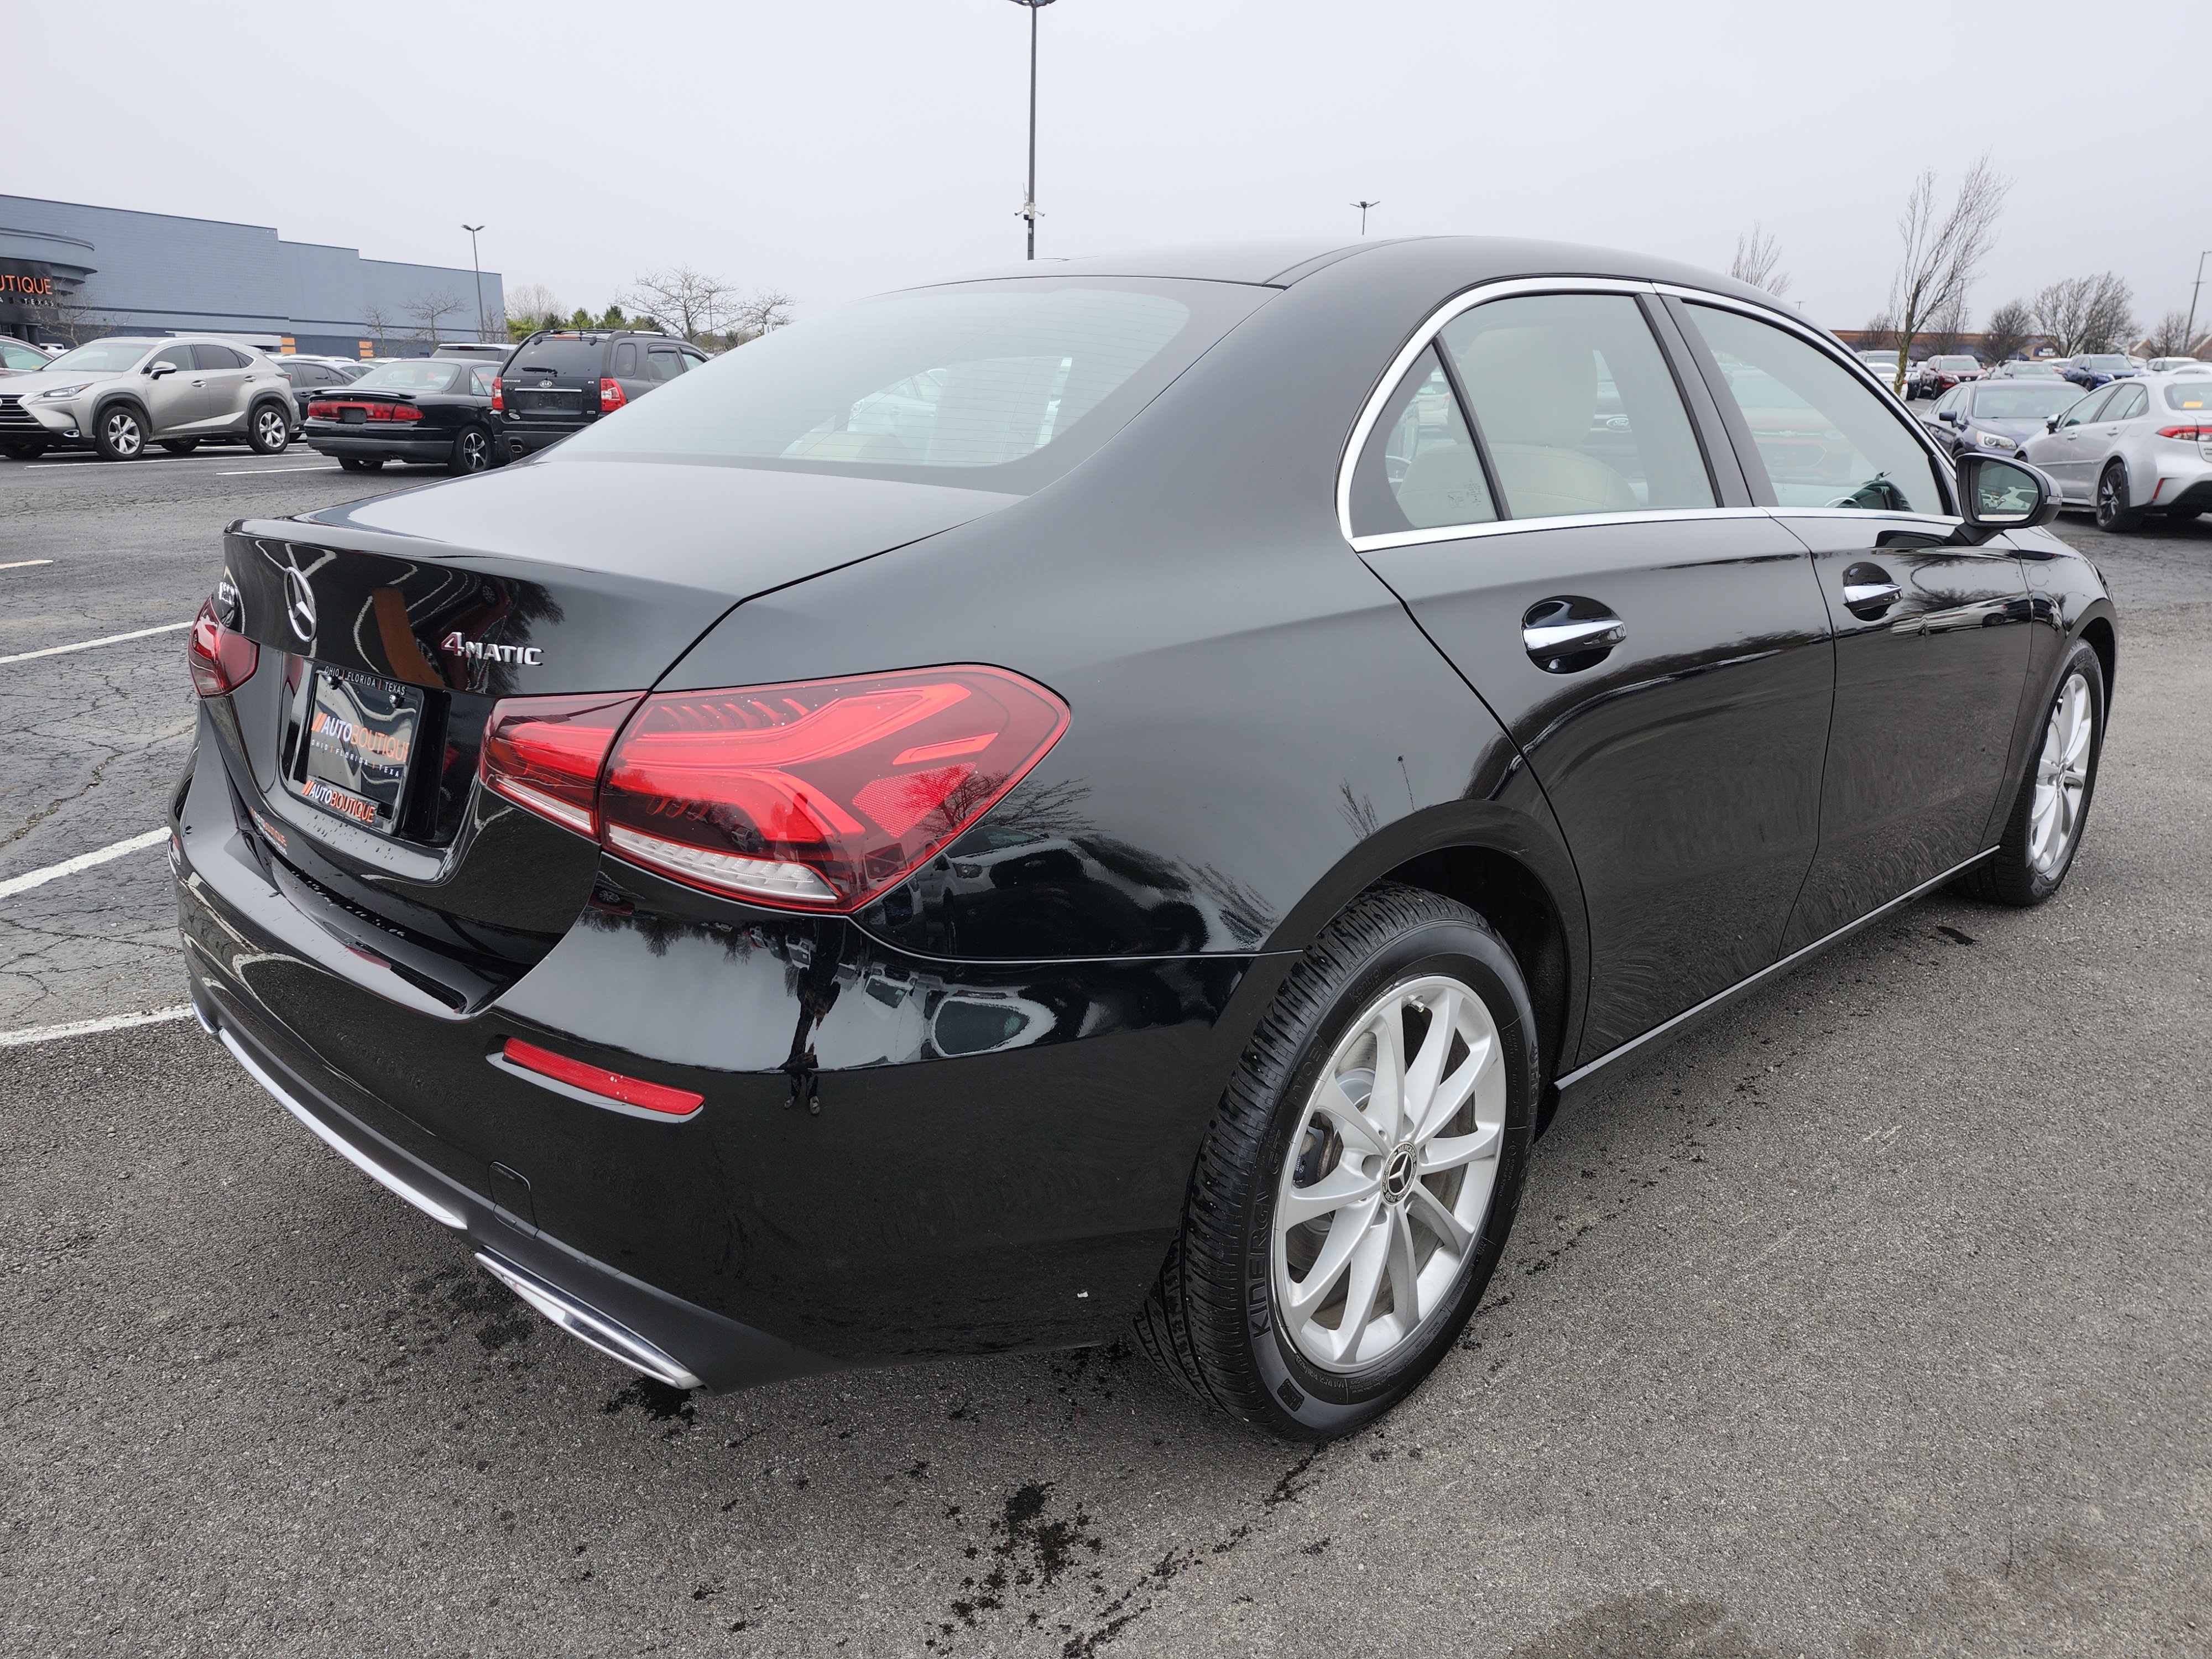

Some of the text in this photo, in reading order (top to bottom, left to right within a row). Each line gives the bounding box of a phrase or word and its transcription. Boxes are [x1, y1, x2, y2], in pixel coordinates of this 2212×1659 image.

[24, 298, 54, 307] TEXAS
[441, 632, 544, 666] 4MATIC
[325, 666, 406, 696] OHIO FLORIDA TEXAS
[311, 739, 328, 750] OHIO
[335, 748, 368, 766] FLORIDA
[309, 784, 377, 823] AUTOBOUTIQUE
[1397, 1144, 1416, 1162] MERCEDES
[1385, 1192, 1397, 1202] BENZ
[1248, 1176, 1271, 1339] KINERGY
